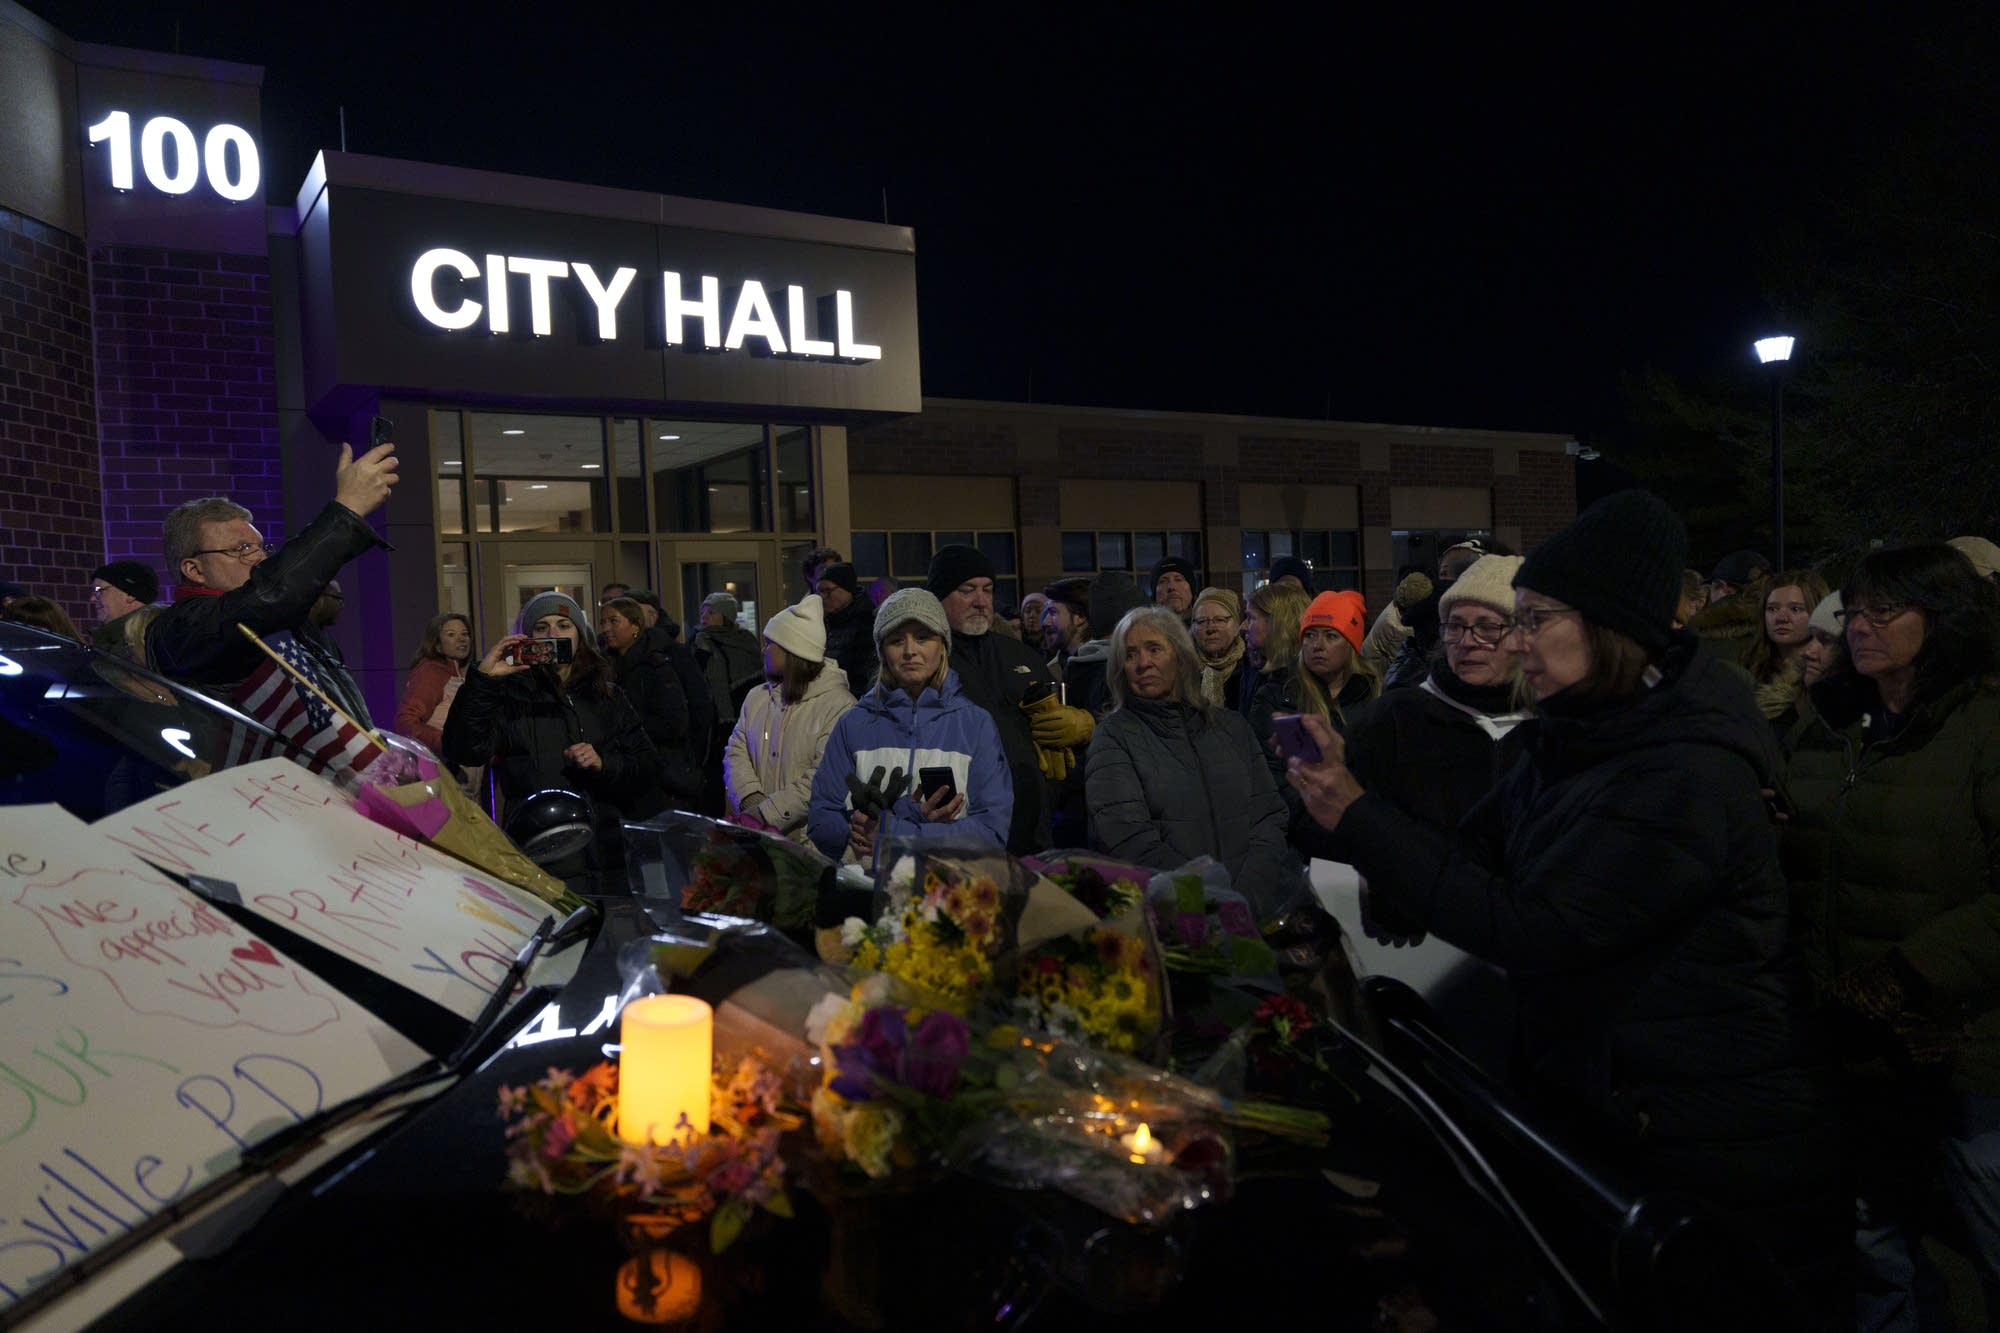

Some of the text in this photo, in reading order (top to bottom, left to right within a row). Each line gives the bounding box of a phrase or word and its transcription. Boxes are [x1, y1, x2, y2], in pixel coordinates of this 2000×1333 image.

[88, 110, 261, 201] 100
[410, 247, 882, 361] CITY HALL
[105, 800, 246, 870] WE
